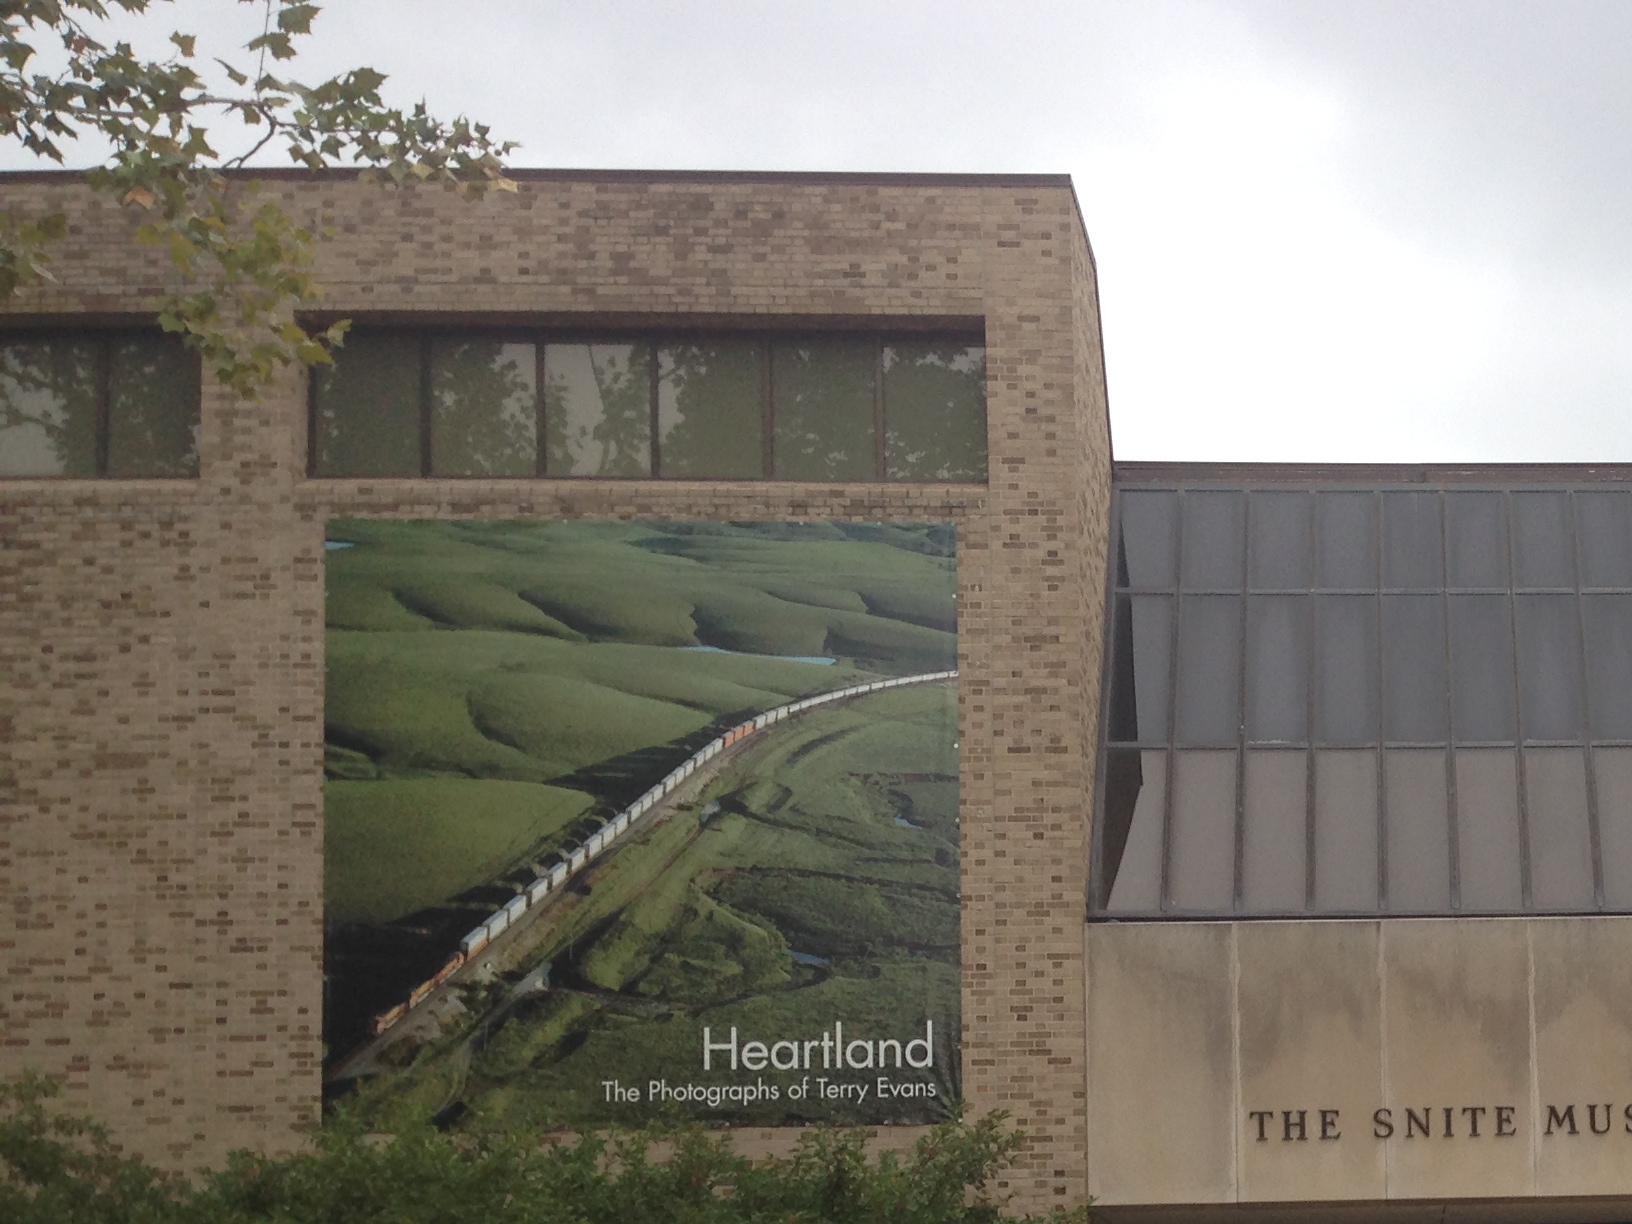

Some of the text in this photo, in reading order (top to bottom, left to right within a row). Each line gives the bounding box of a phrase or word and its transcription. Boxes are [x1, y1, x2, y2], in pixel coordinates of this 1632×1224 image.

[703, 1020, 934, 1070] Heartland
[602, 1077, 936, 1107] The Photographs of Terry Evans
[1250, 1109, 1343, 1142] THE
[1372, 1106, 1518, 1140] SNITE
